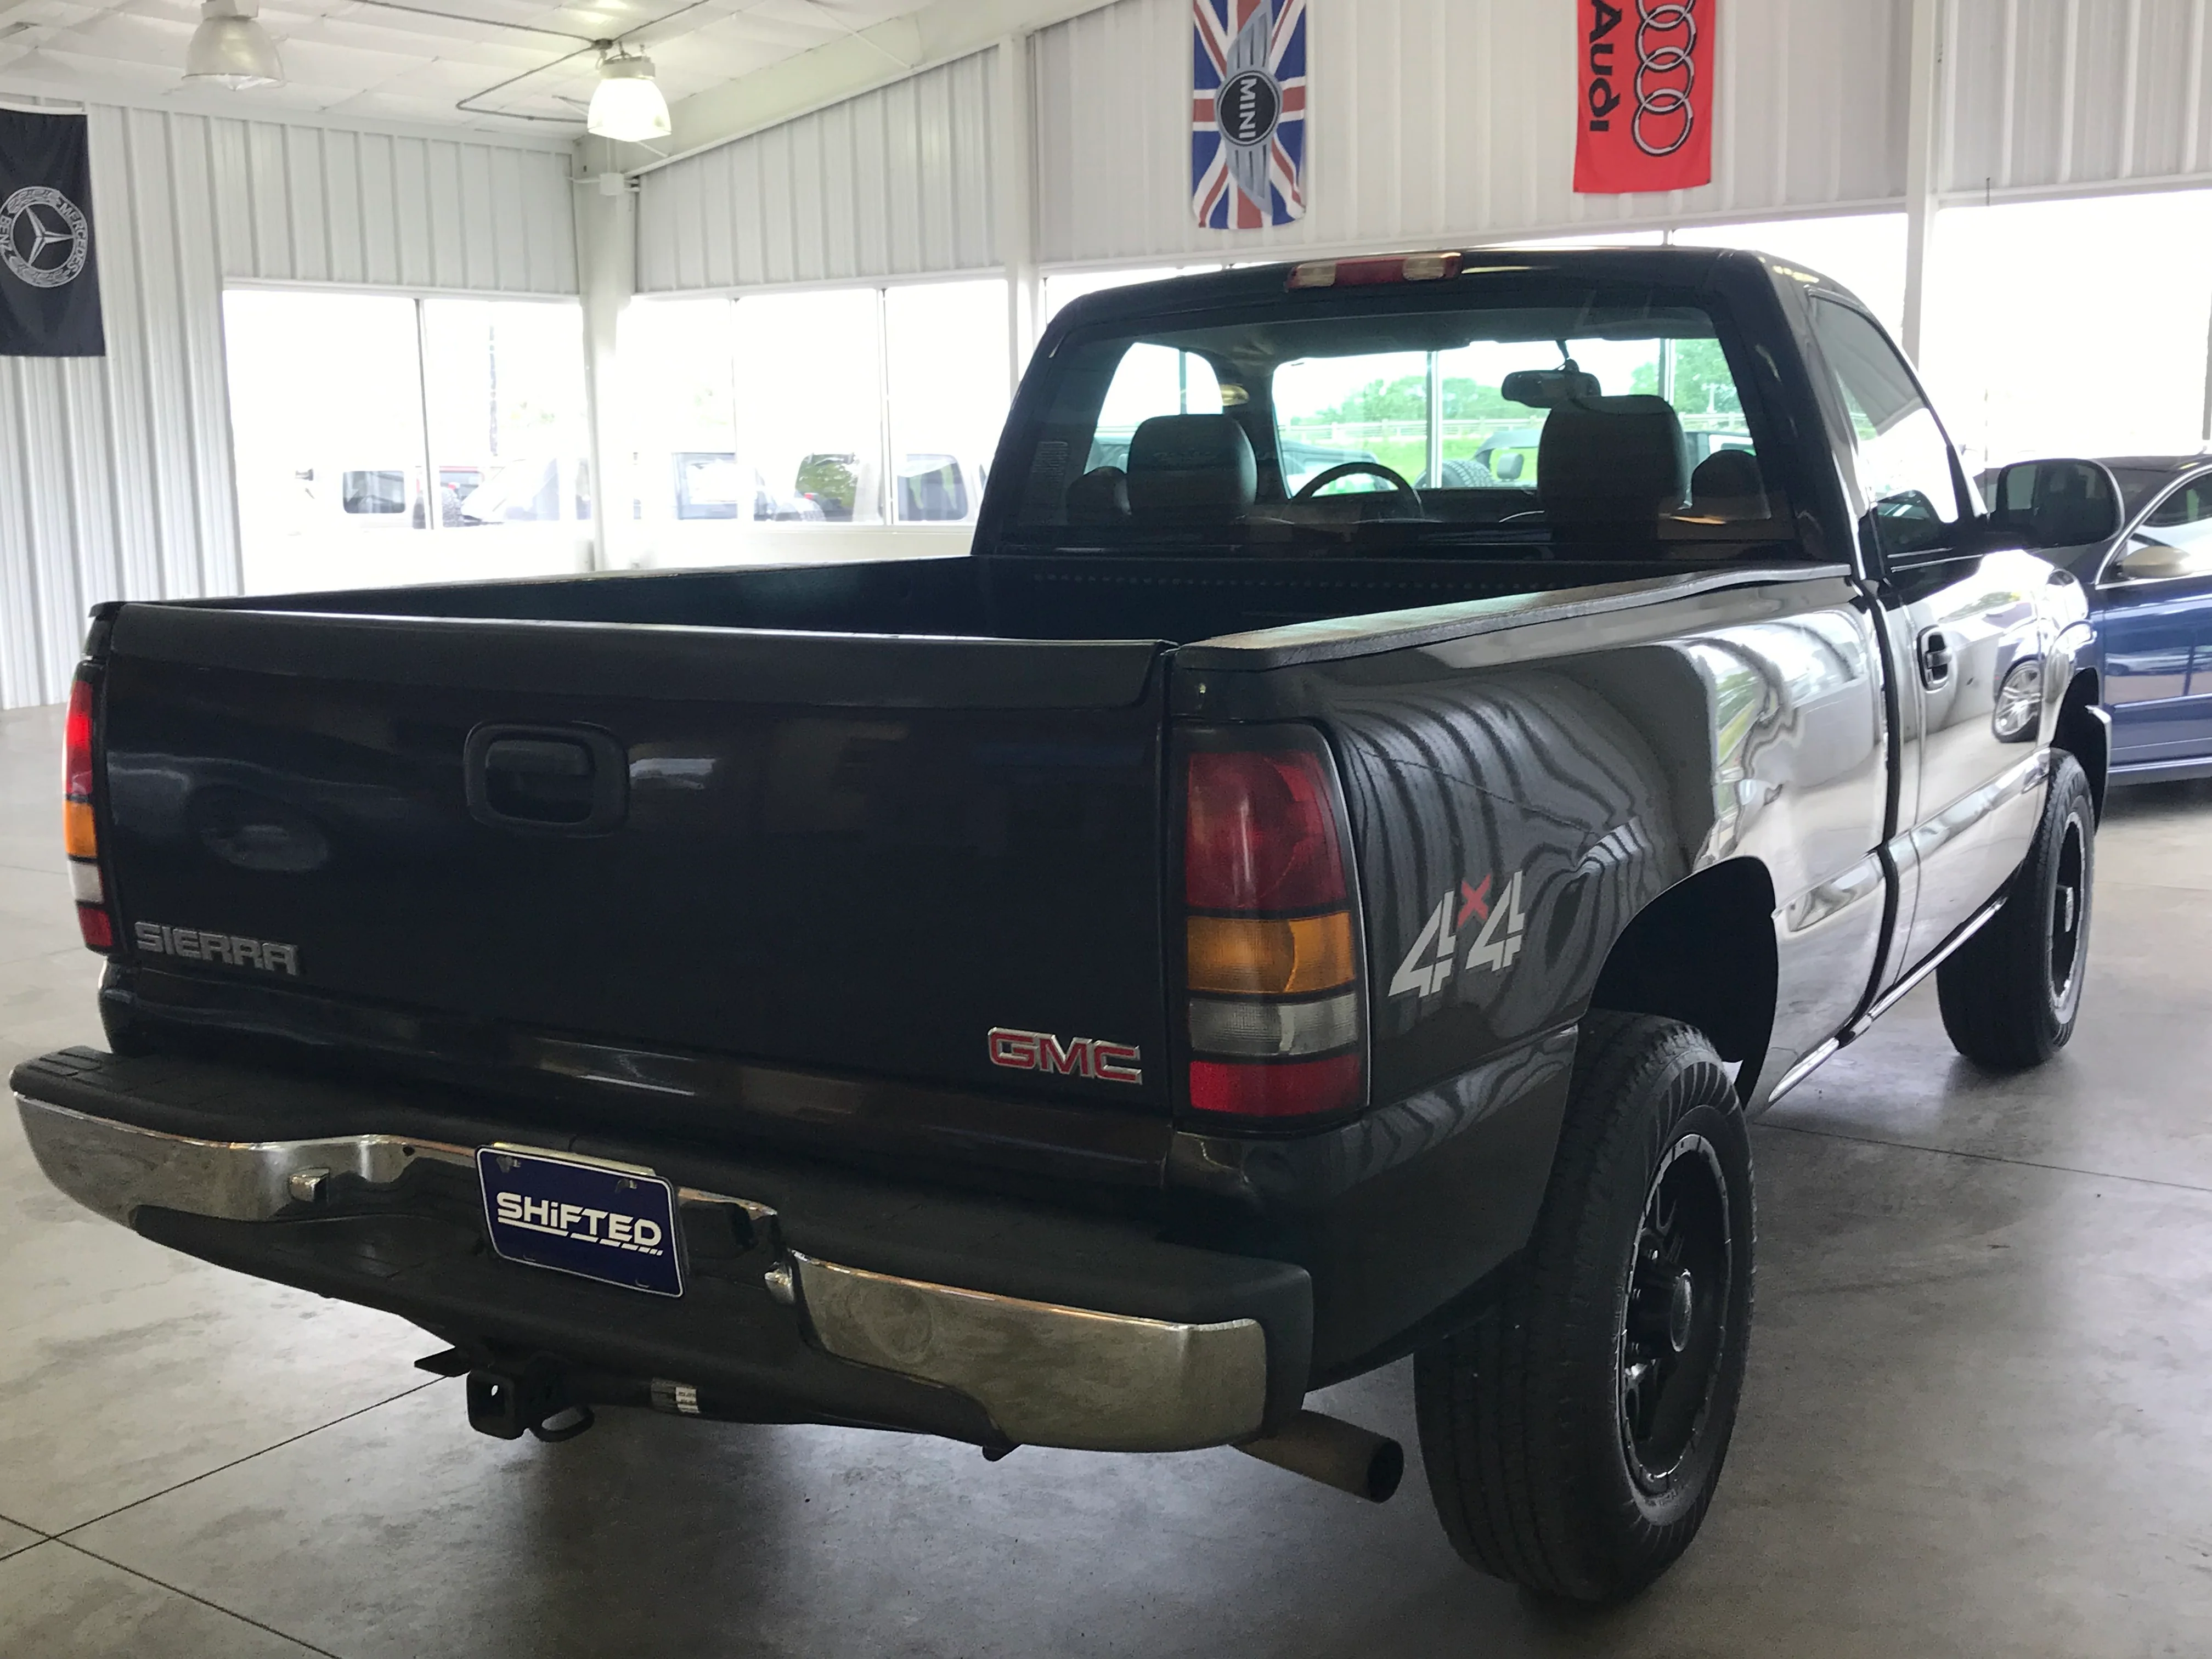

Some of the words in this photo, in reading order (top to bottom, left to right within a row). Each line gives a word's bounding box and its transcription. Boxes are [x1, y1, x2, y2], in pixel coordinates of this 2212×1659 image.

[1589, 0, 1622, 132] Audi
[1239, 78, 1257, 139] MINI
[59, 202, 87, 273] MERCEDES
[135, 921, 300, 976] SIERRA
[988, 1026, 1143, 1085] GMC
